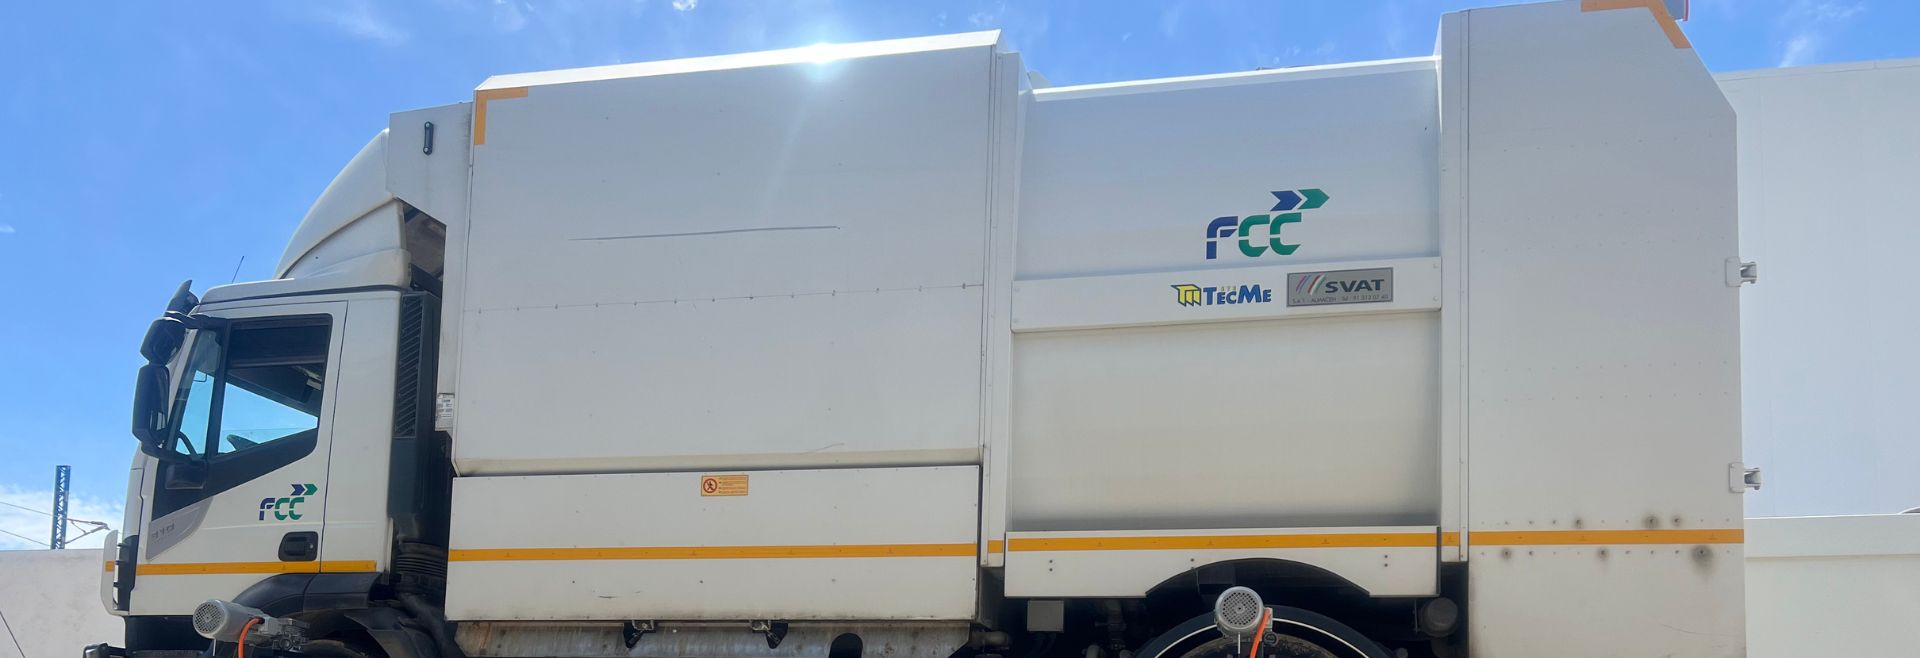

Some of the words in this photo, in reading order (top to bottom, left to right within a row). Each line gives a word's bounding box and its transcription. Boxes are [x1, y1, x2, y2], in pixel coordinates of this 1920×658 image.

[1206, 212, 1302, 260] FCC
[1325, 279, 1385, 293] SVAT
[259, 497, 305, 521] FCC
